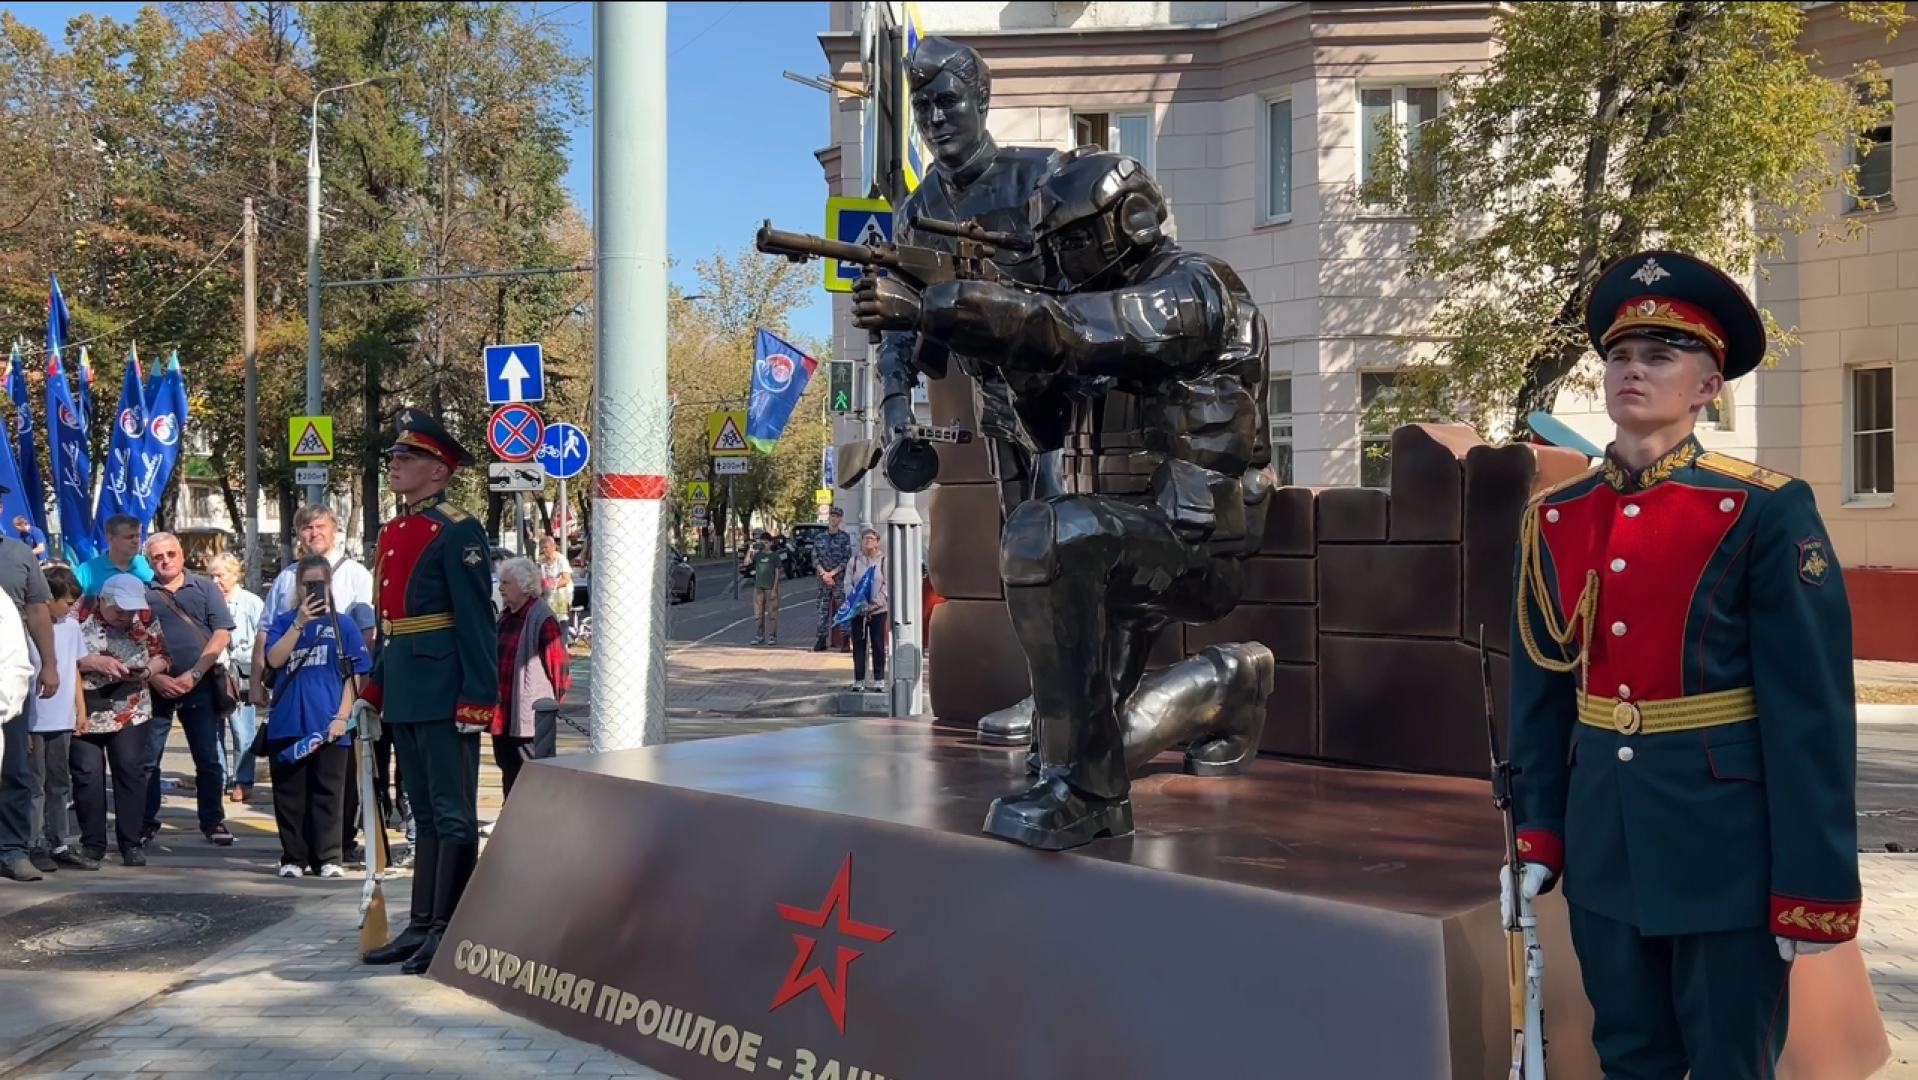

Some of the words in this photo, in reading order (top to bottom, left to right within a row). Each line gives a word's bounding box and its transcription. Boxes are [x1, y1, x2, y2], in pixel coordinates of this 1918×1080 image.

[454, 939, 595, 1014] СОХРАНЯЯ
[595, 983, 763, 1073] ПРОШЛОЕ
[767, 1056, 783, 1070] -
